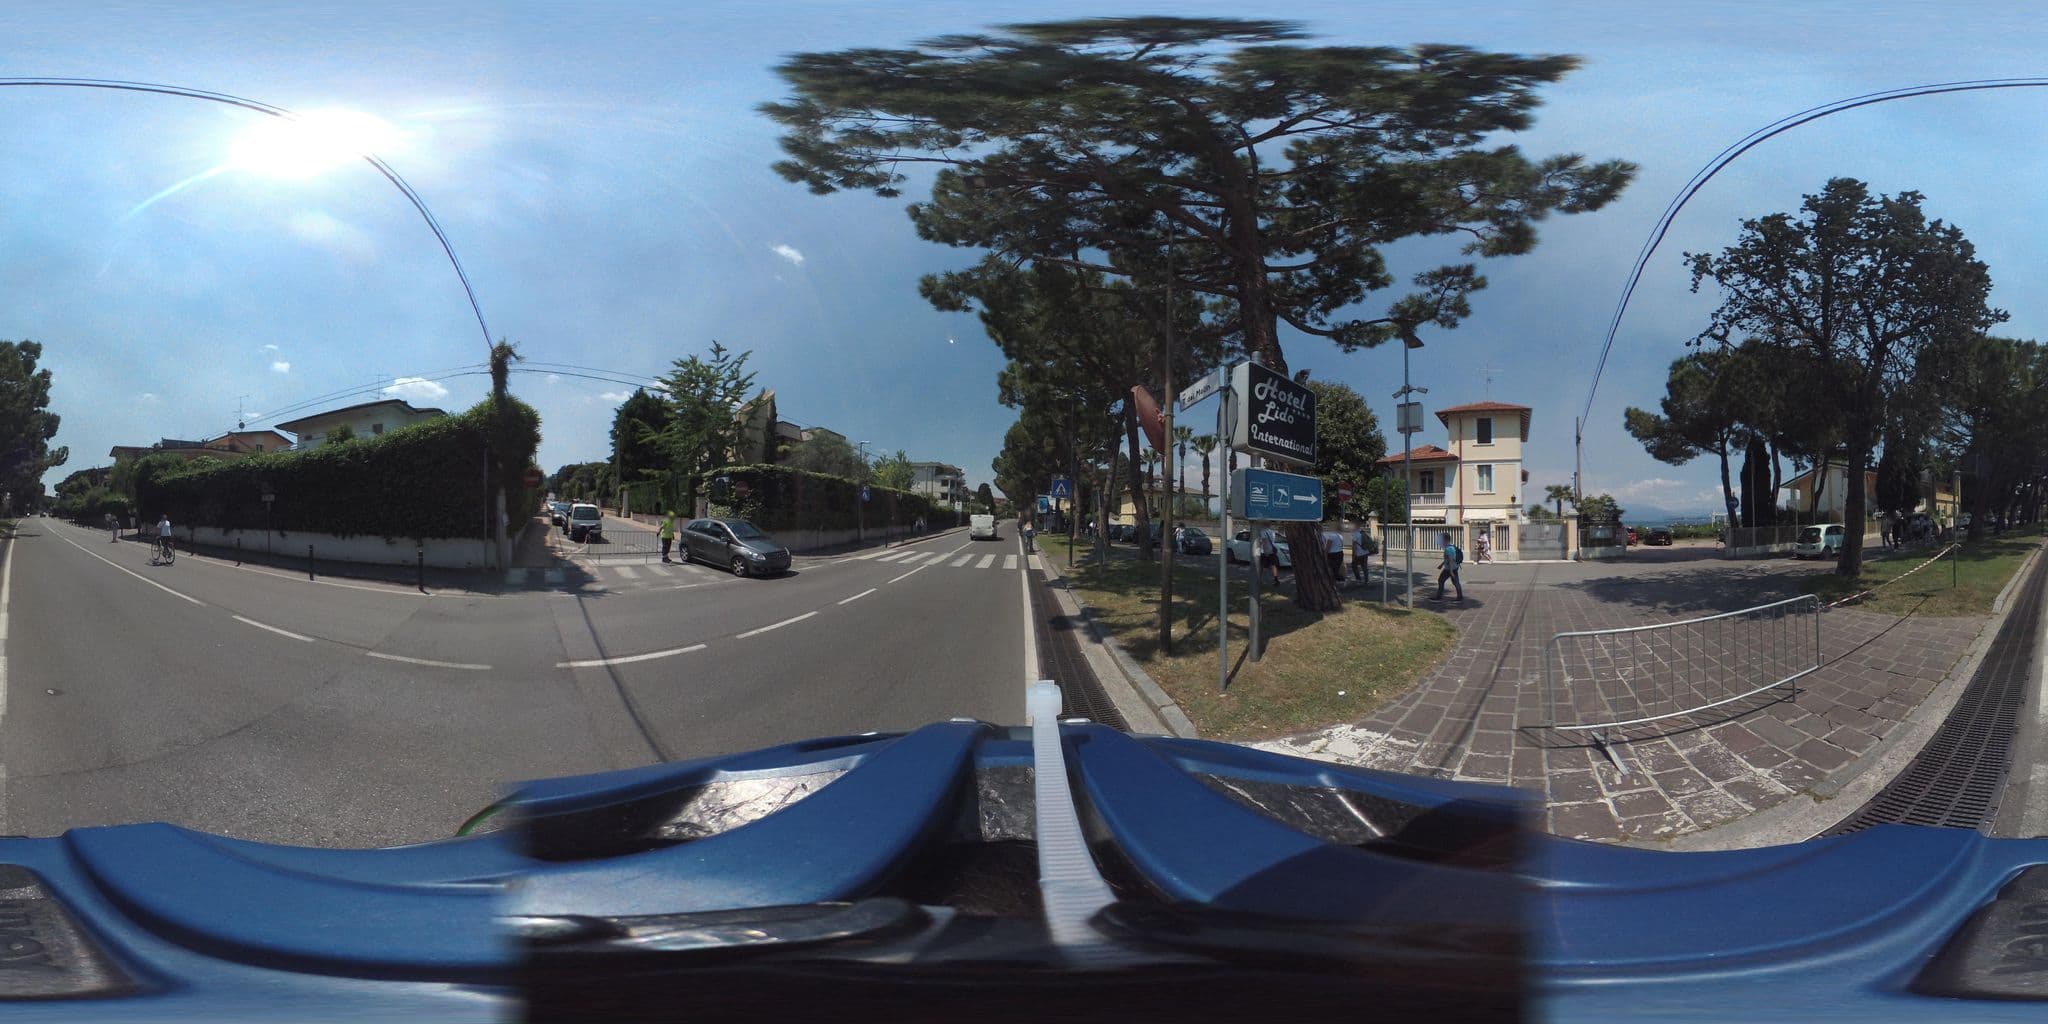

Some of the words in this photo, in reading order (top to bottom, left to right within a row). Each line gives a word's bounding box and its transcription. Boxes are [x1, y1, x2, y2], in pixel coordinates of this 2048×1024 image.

[1254, 377, 1307, 411] Hotel
[1257, 401, 1295, 425] Lido
[1250, 423, 1313, 456] International
